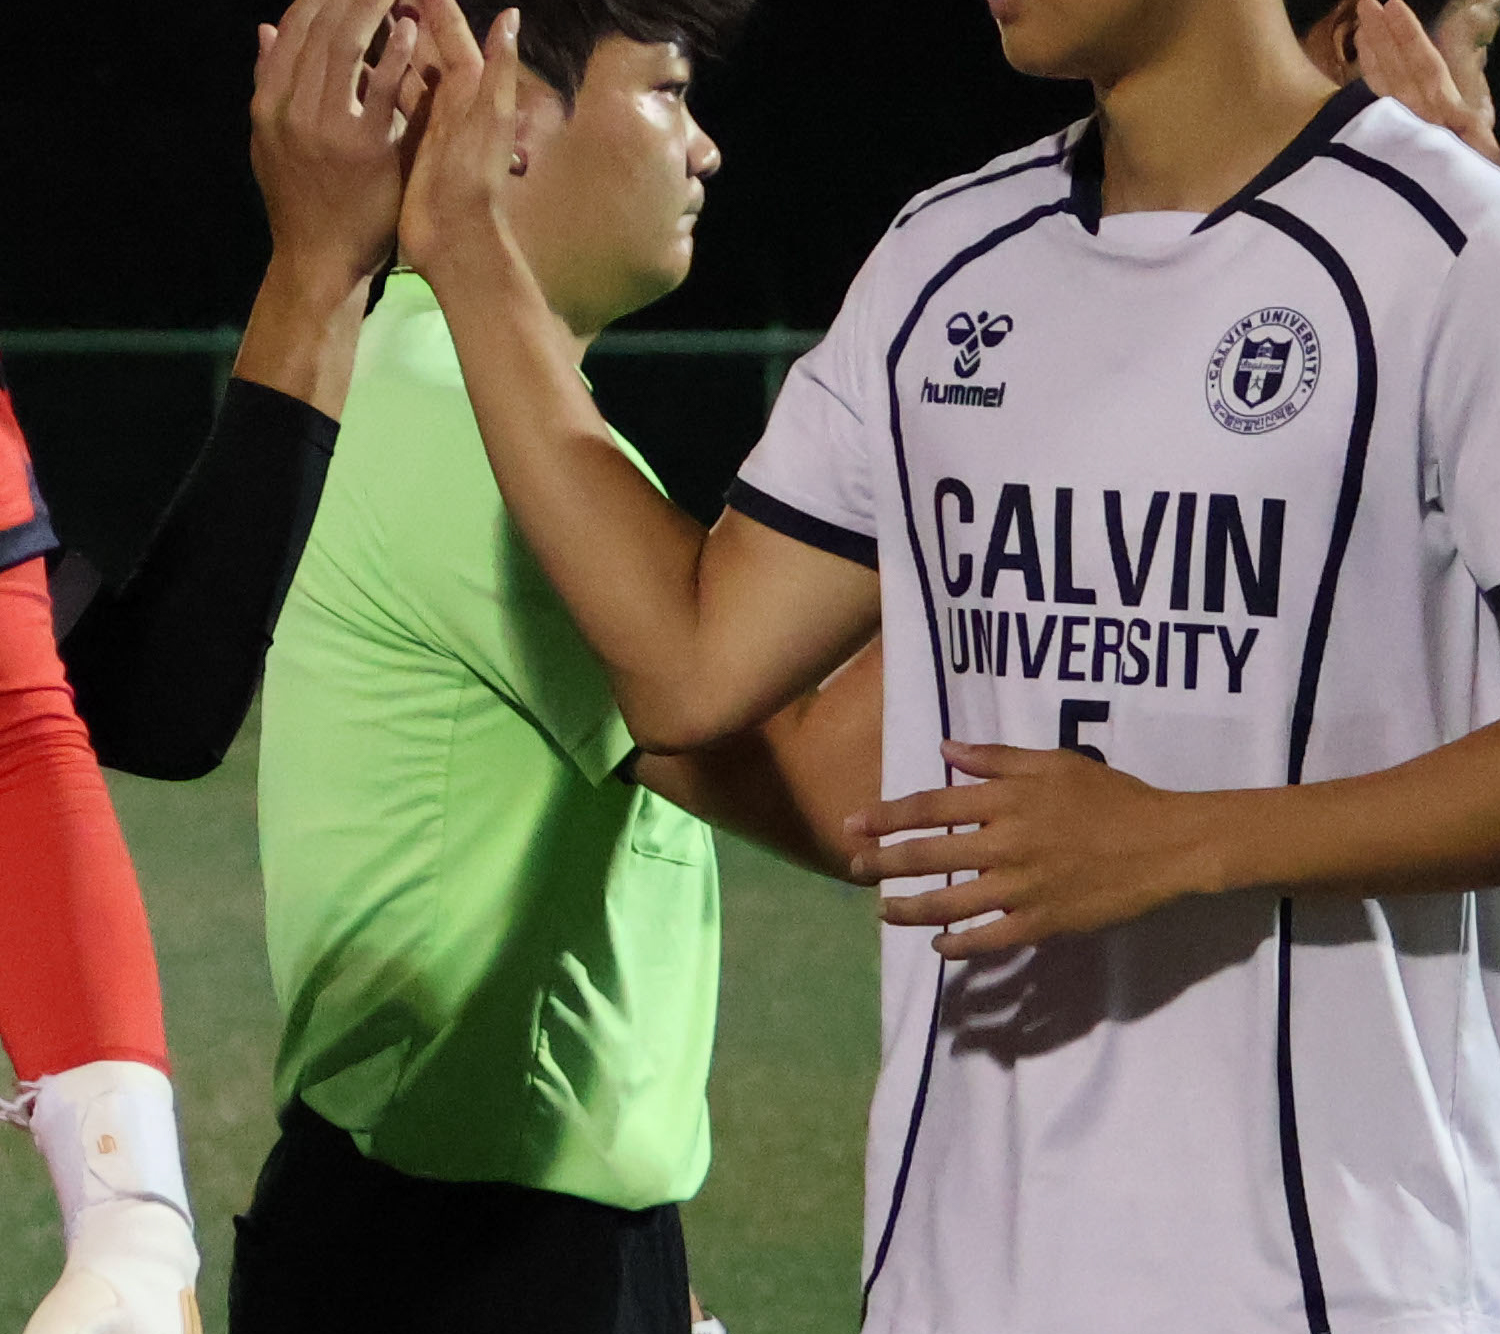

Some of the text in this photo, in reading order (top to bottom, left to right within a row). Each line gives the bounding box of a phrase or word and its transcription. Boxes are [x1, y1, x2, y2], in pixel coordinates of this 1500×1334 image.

[1209, 310, 1317, 389] CALVIN UNIVERSITY
[920, 376, 1007, 408] hummel
[934, 477, 1287, 618] CALVIN
[947, 607, 1260, 694] UNIVERSITY
